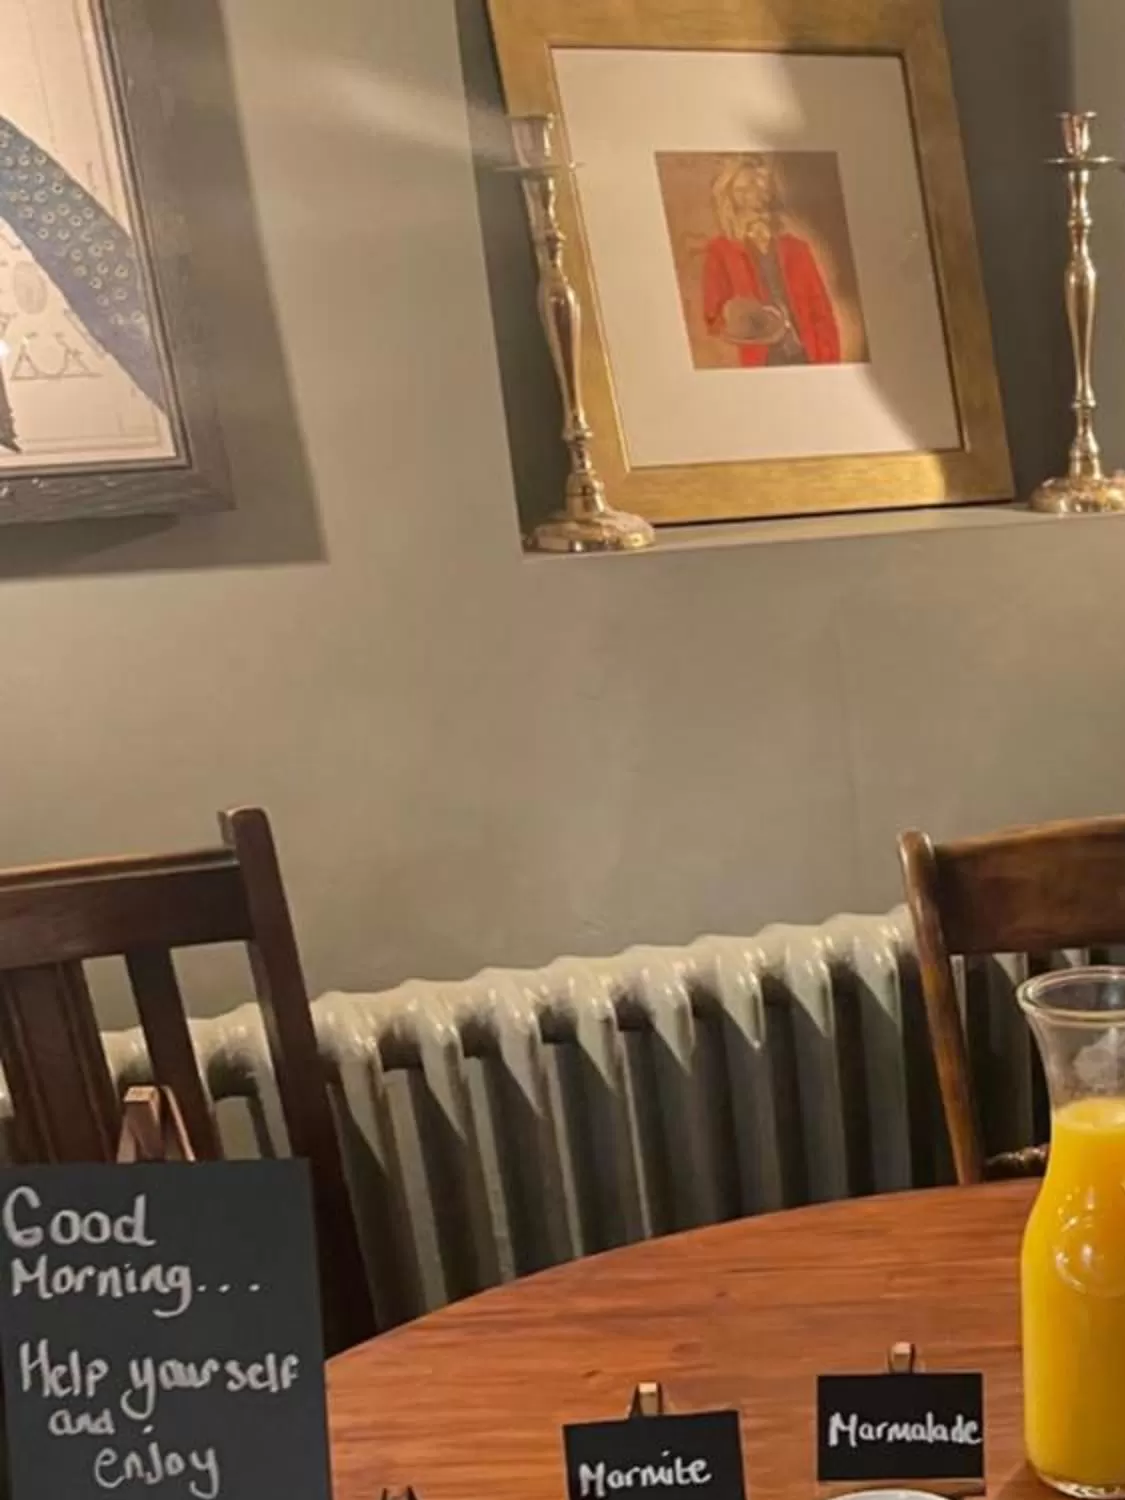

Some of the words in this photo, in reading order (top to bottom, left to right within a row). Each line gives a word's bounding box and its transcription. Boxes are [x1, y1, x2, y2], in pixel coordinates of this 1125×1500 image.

[3, 1186, 156, 1247] Good
[20, 1338, 109, 1398] Help
[48, 1408, 115, 1436] and
[828, 1411, 982, 1448] Marmalade
[94, 1425, 219, 1500] enjoy
[579, 1450, 712, 1497] Marmite
